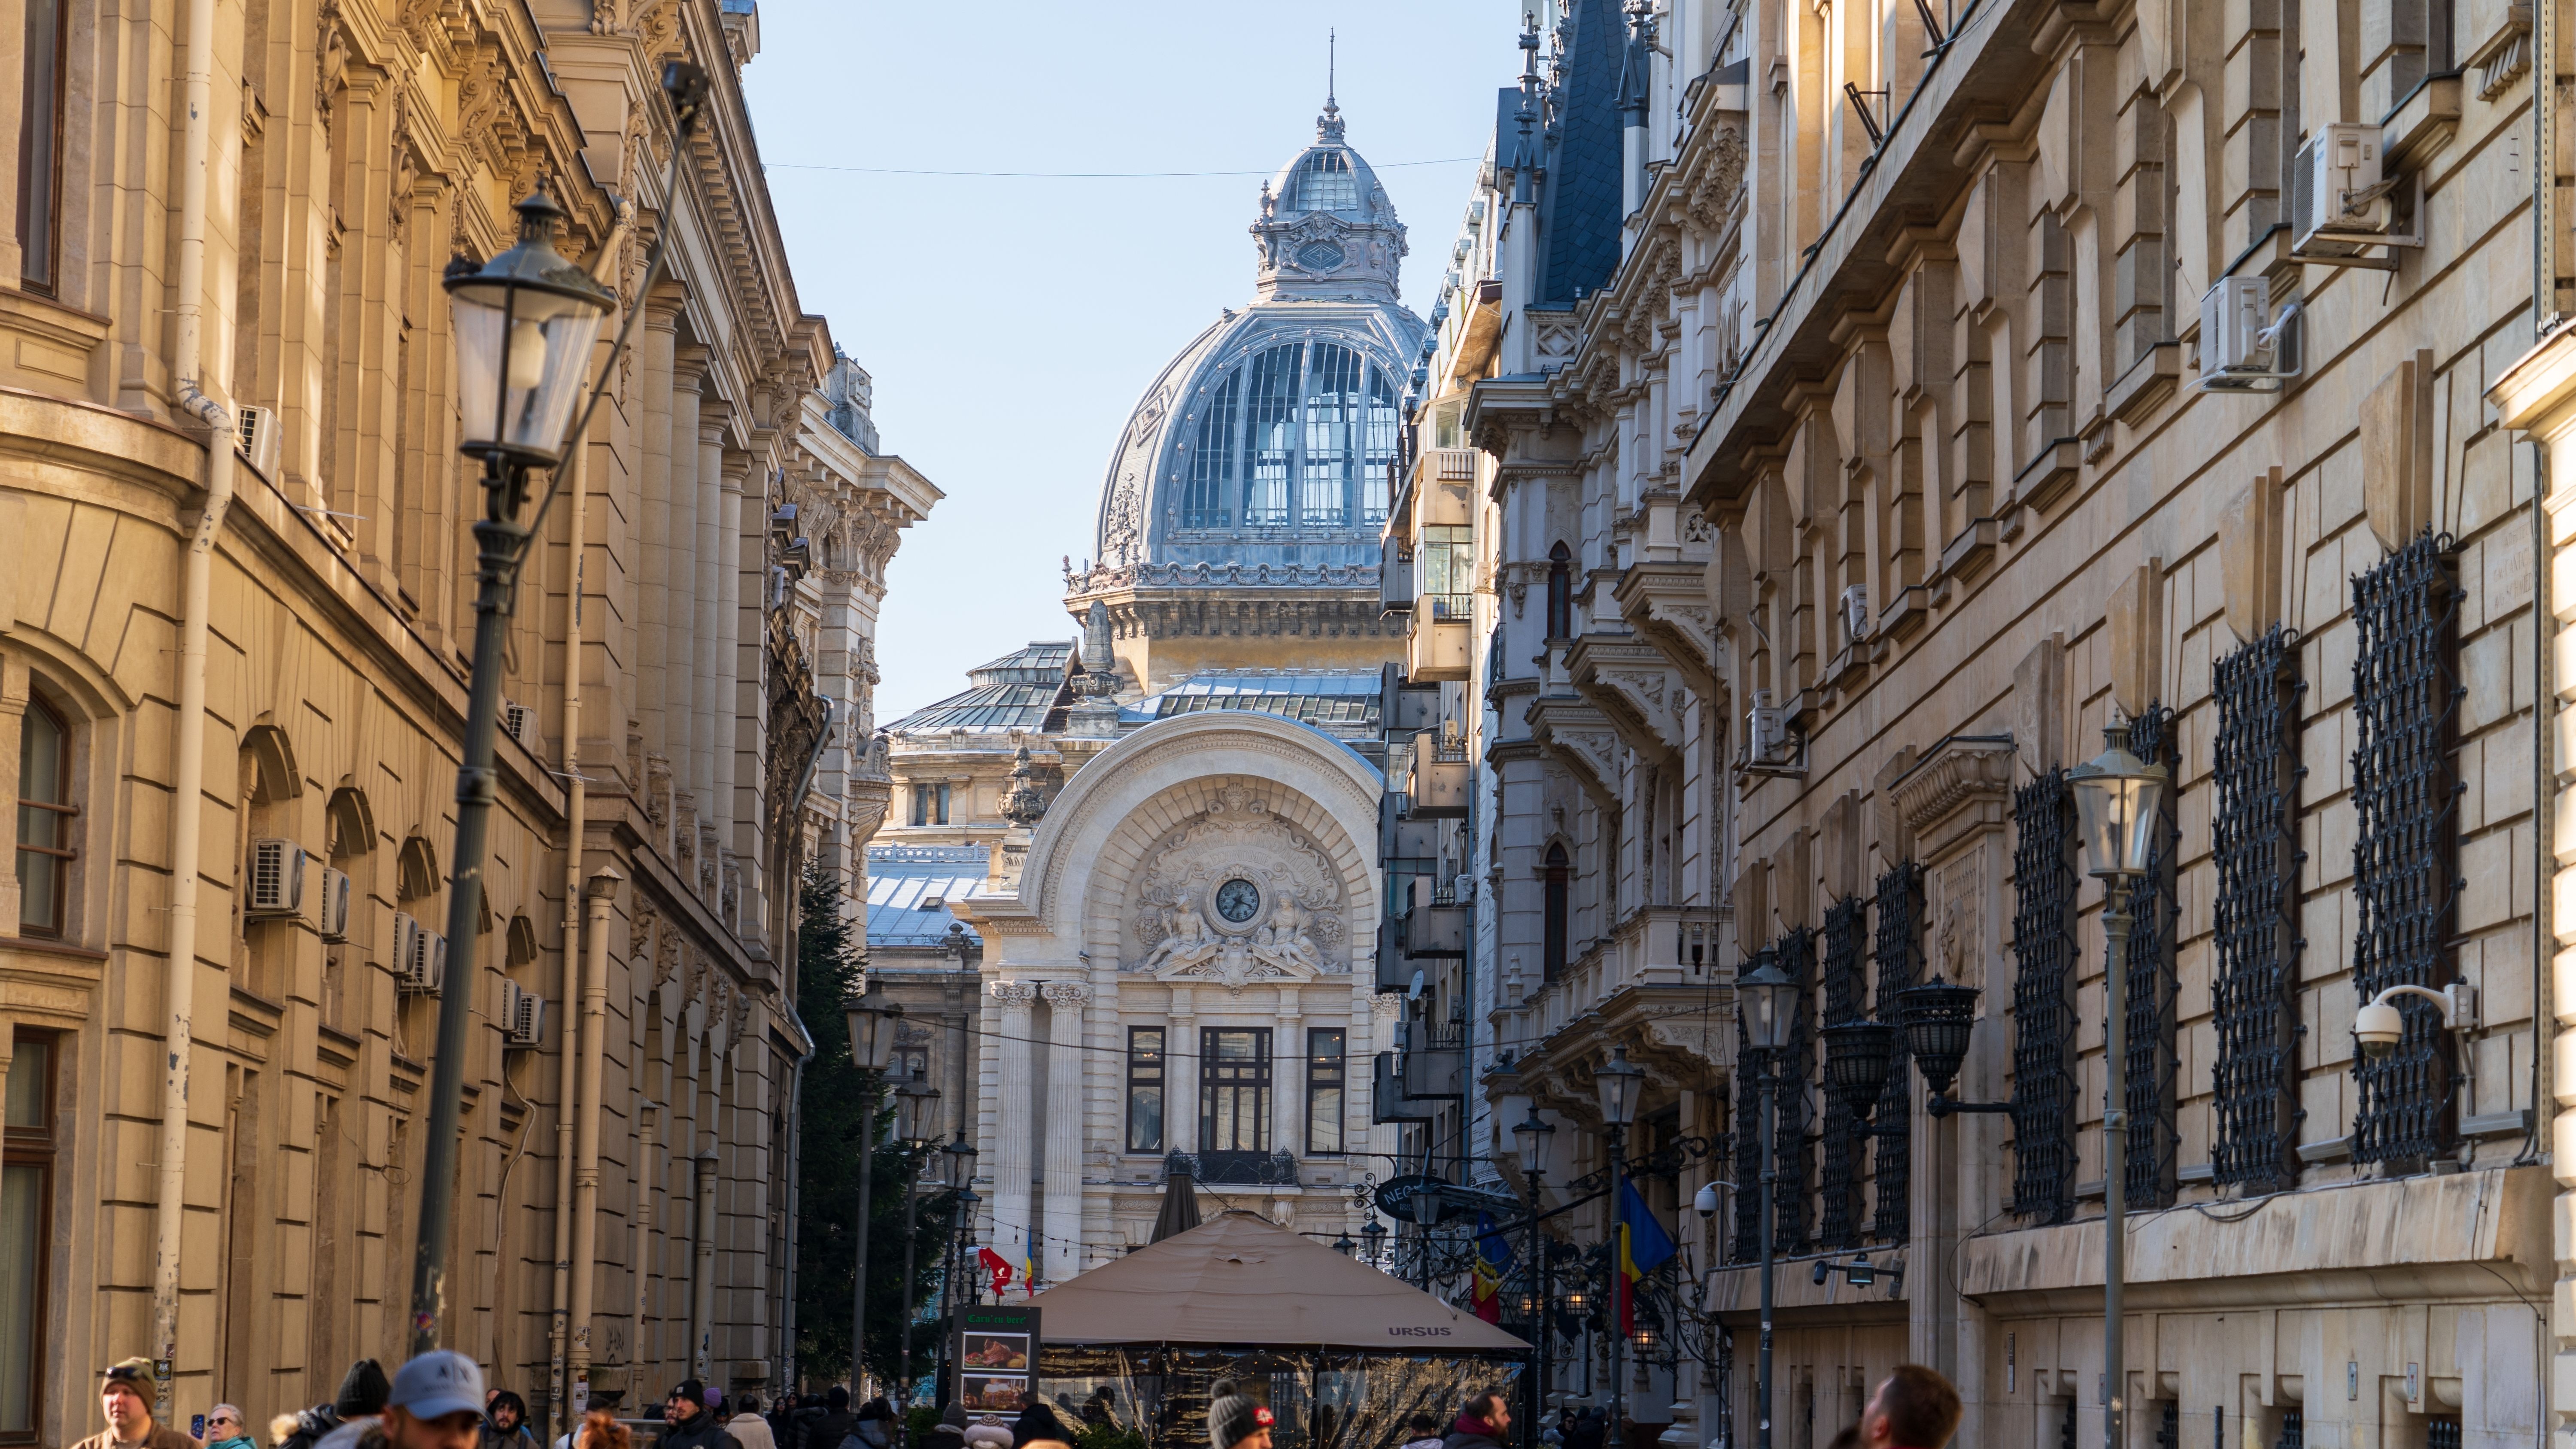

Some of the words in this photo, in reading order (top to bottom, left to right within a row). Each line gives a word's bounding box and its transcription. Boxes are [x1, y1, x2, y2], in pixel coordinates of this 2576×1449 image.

[1160, 861, 1182, 887] CASA
[1188, 833, 1237, 859] DEPUNERI
[1210, 850, 1272, 866] ECONOMIE
[1389, 1327, 1452, 1336] URSUS
